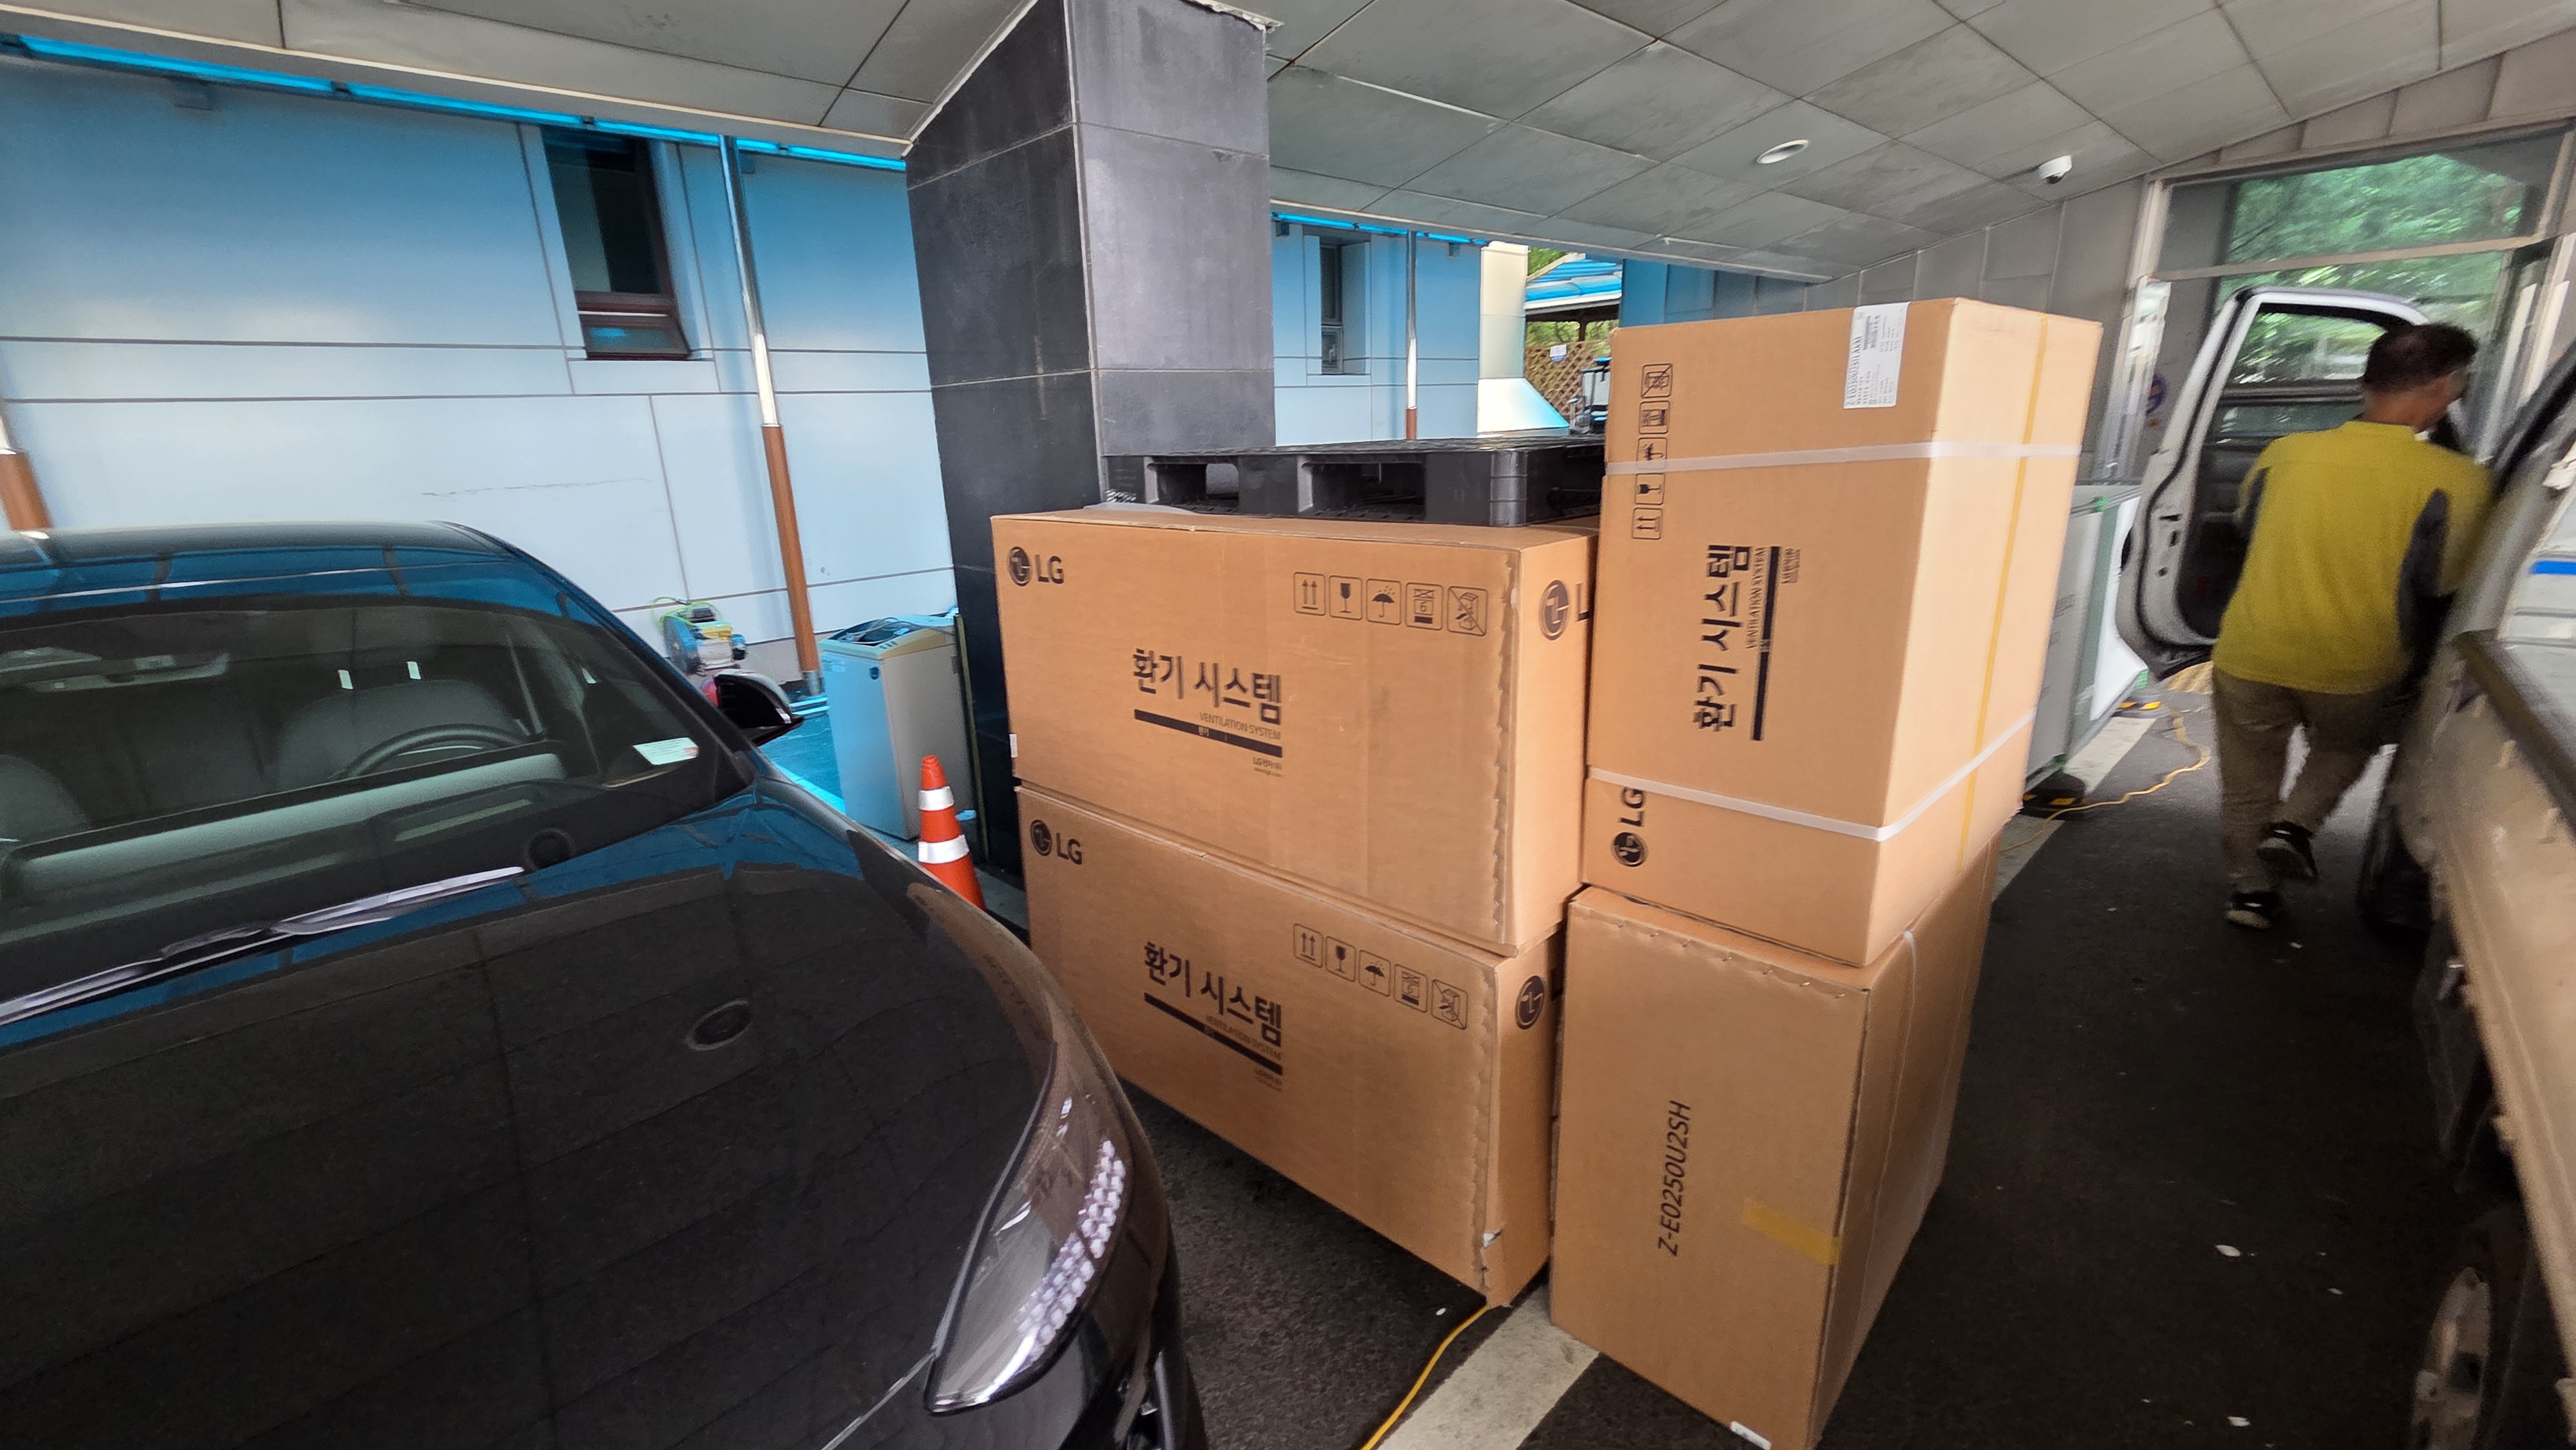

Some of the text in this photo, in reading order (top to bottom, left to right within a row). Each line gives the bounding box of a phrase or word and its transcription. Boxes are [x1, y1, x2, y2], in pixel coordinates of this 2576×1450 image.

[1034, 554, 1064, 584] LG
[1575, 583, 1589, 622] L
[1693, 545, 1752, 732] 환기 시스템
[1132, 648, 1282, 726] 환기 시스템
[1199, 711, 1282, 740] VENTILATION SYSTEM
[1618, 786, 1645, 827] LG
[1056, 833, 1083, 865] LG
[1144, 941, 1282, 1048] 환기 시스템
[1657, 1100, 1691, 1257] Z-E0250U2SH
